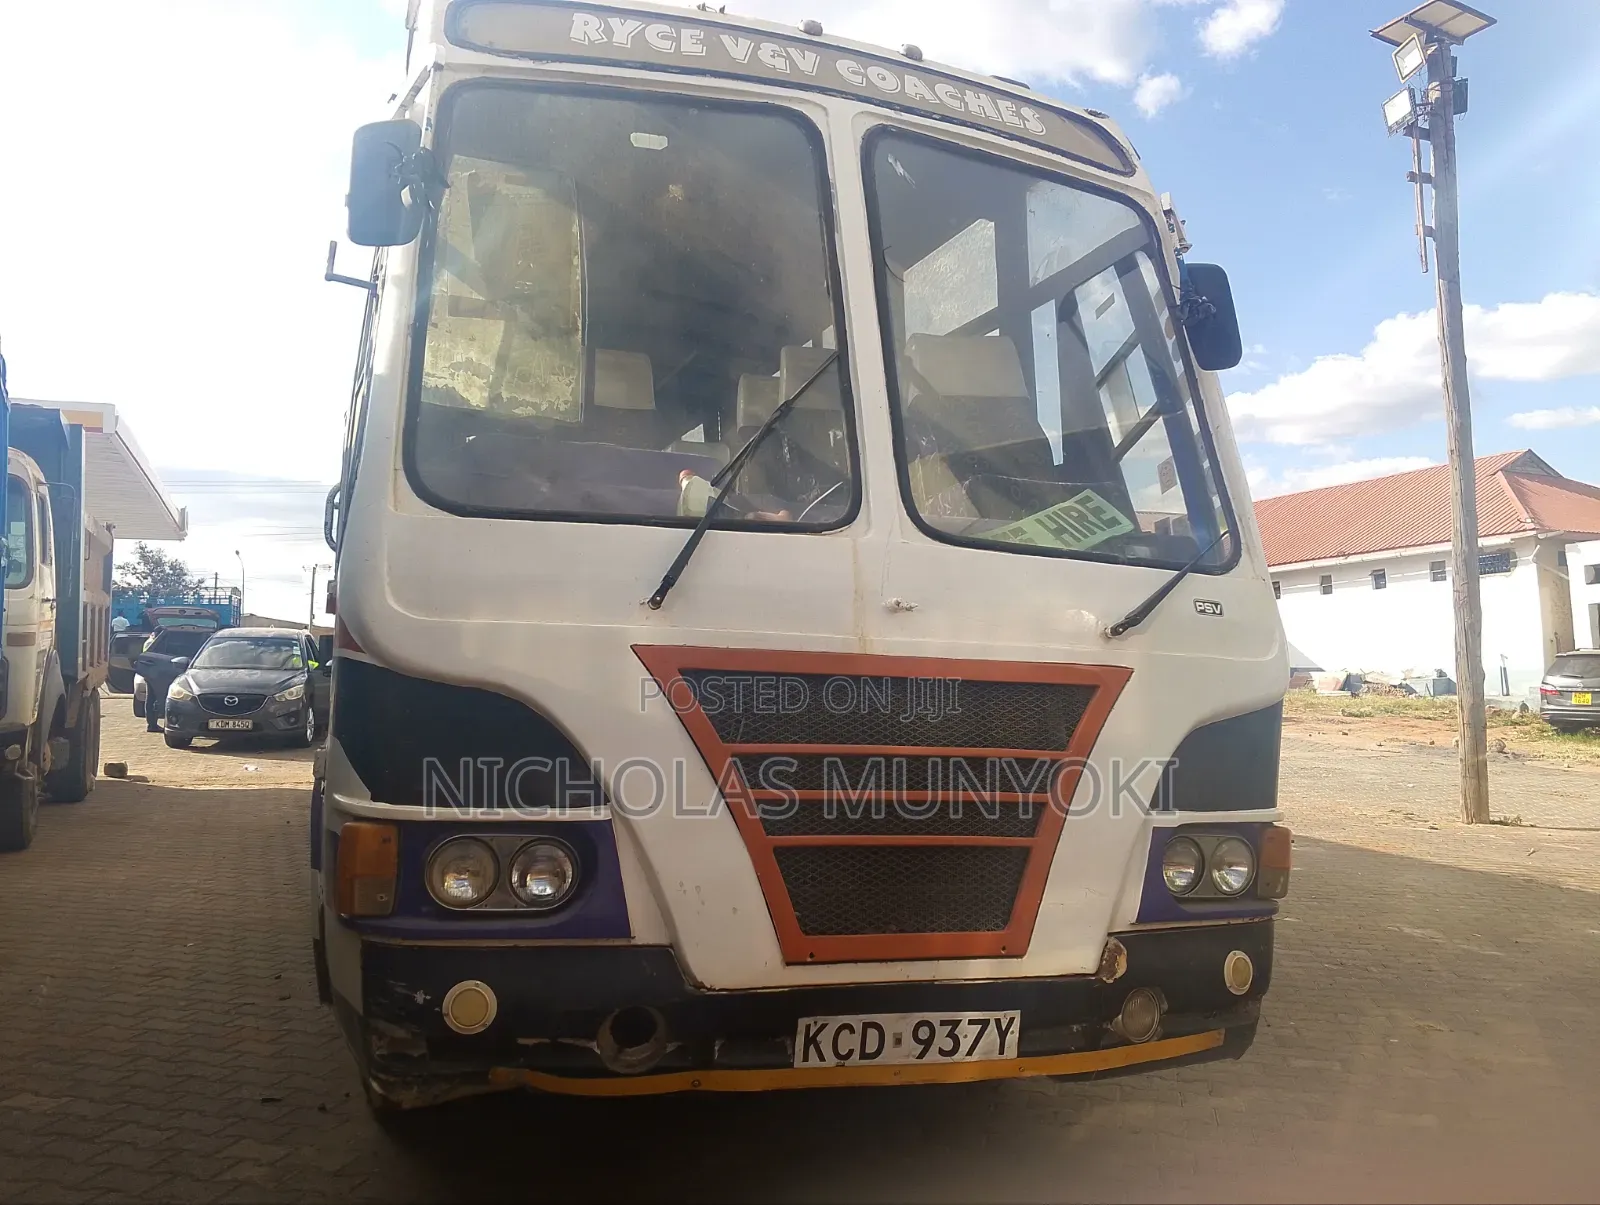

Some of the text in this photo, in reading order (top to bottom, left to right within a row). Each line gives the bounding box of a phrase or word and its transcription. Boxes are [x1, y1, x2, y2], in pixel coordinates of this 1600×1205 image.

[569, 12, 706, 56] RYCE
[835, 59, 1047, 135] COACHES
[1033, 494, 1122, 548] HIRE
[1195, 601, 1221, 614] PSV
[801, 1016, 1016, 1062] KCD 937Y
